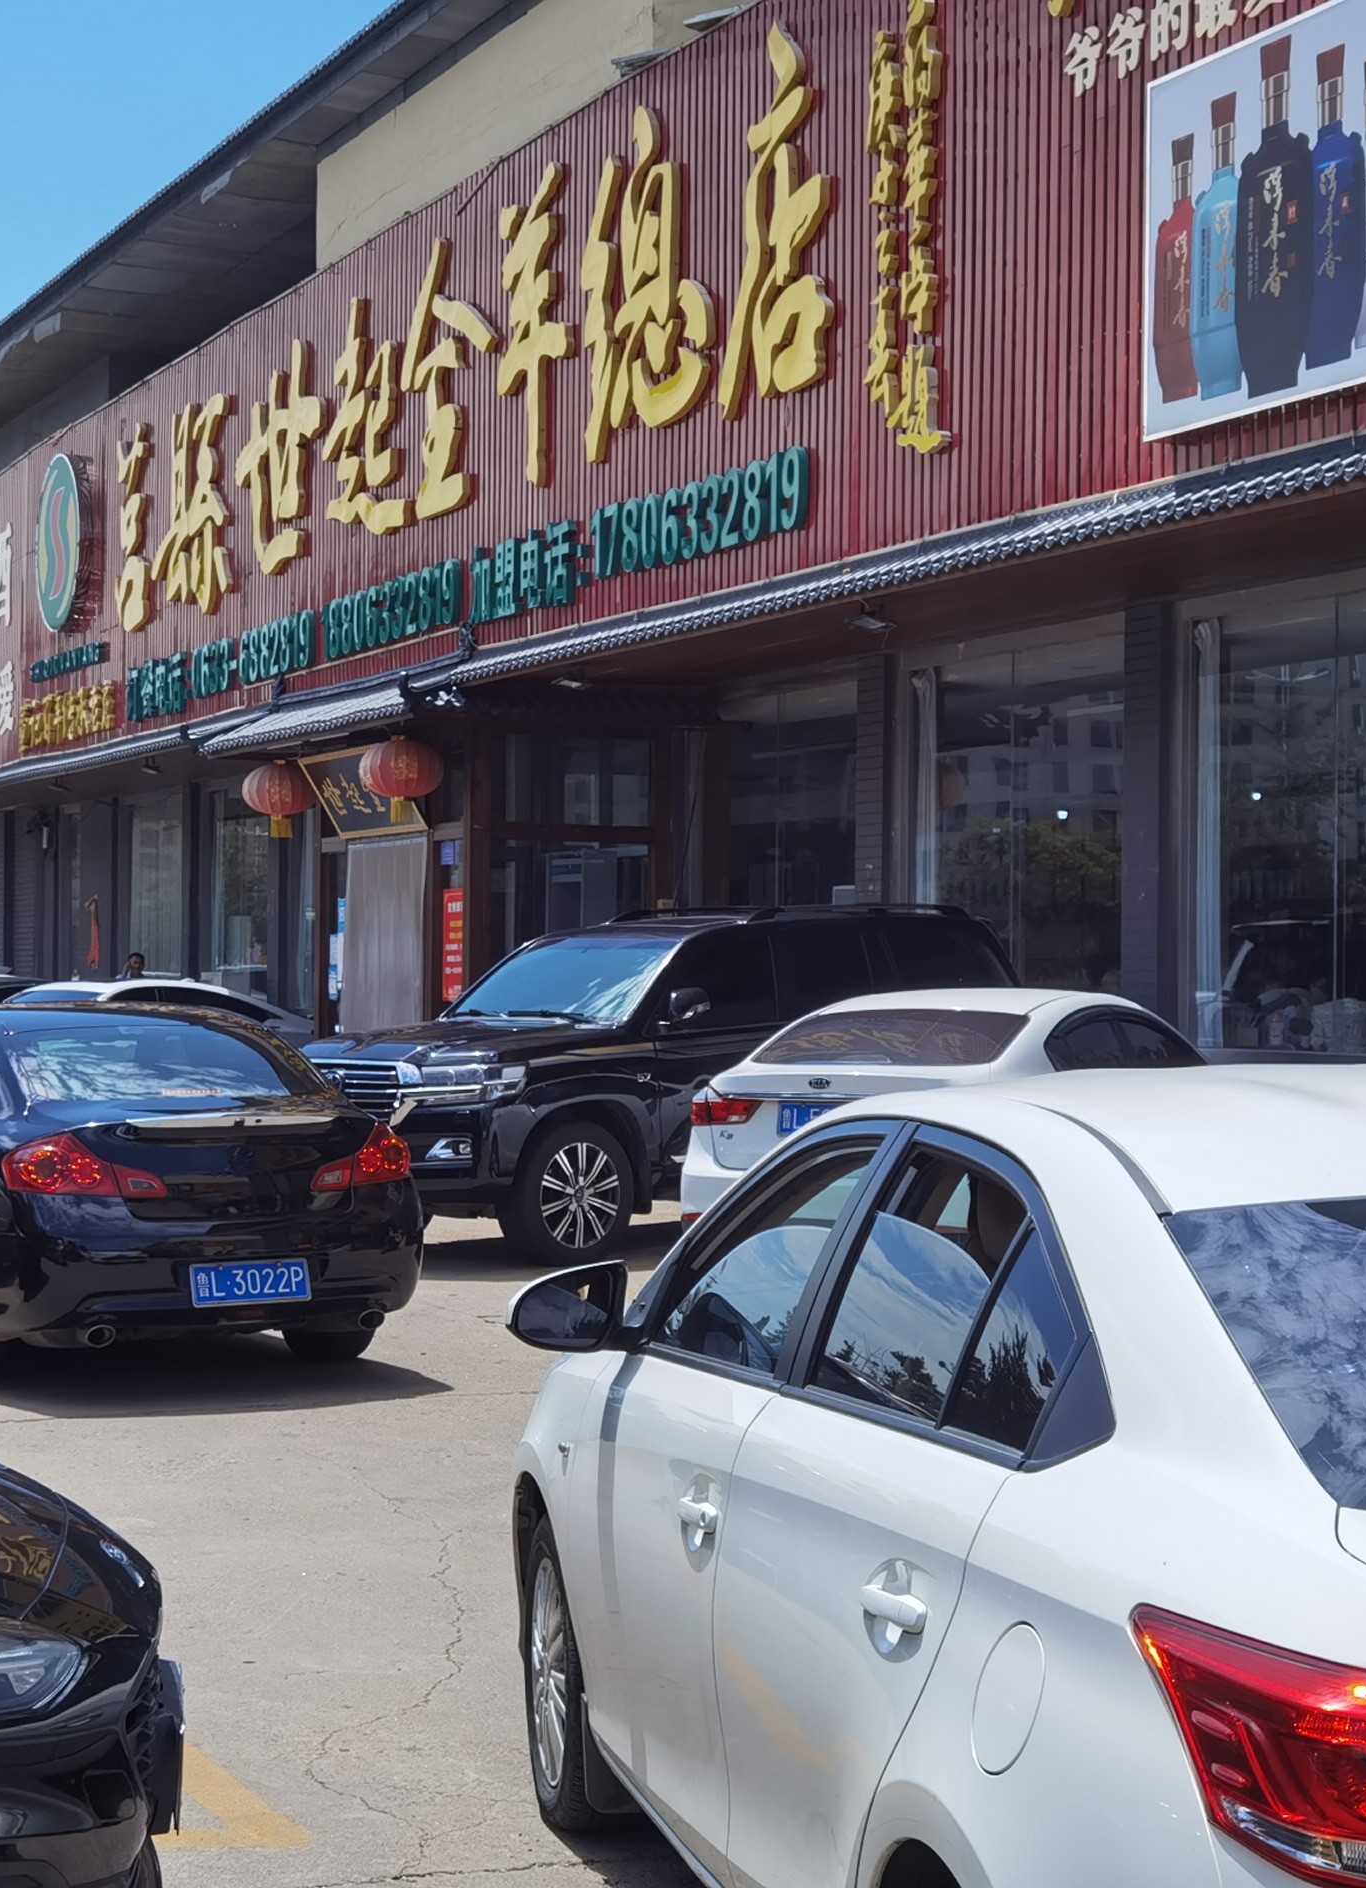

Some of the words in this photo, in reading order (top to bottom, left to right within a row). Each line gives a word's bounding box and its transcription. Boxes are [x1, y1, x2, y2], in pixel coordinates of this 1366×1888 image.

[1063, 0, 1283, 98] 爷爷的最
[197, 1267, 303, 1298] 鲁L·3022P
